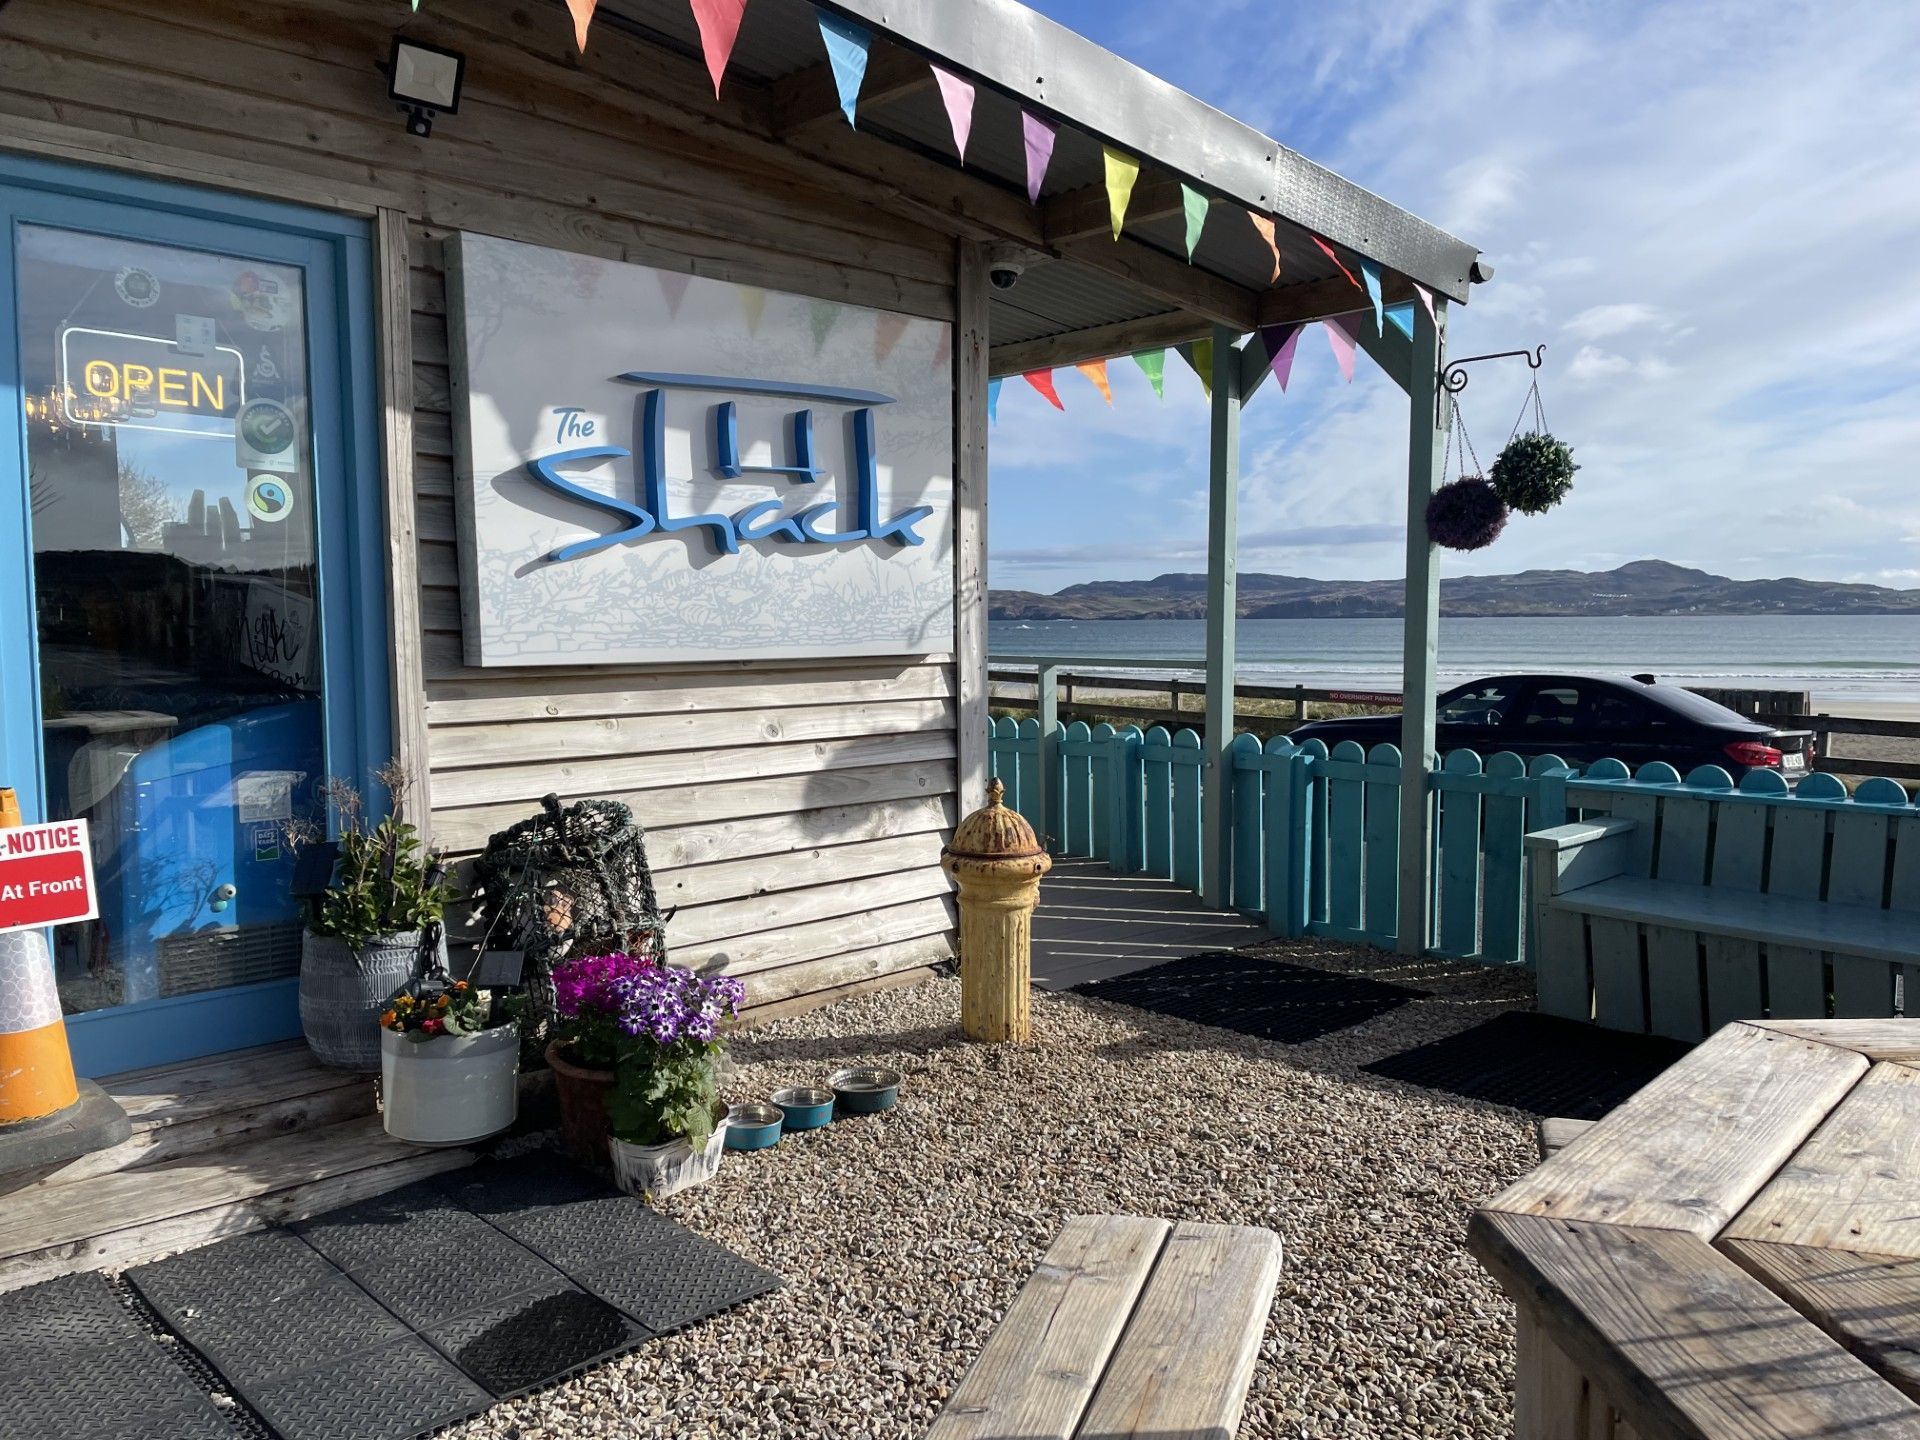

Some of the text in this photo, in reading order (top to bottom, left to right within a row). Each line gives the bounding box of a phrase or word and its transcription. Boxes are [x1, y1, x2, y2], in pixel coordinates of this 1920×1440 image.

[84, 359, 224, 411] OPEN
[552, 407, 595, 444] The
[526, 387, 935, 562] Shack
[1329, 692, 1402, 703] NO OVERNIGHT PARKING
[0, 825, 80, 856] -NOTICE
[1, 875, 83, 902] At Front
